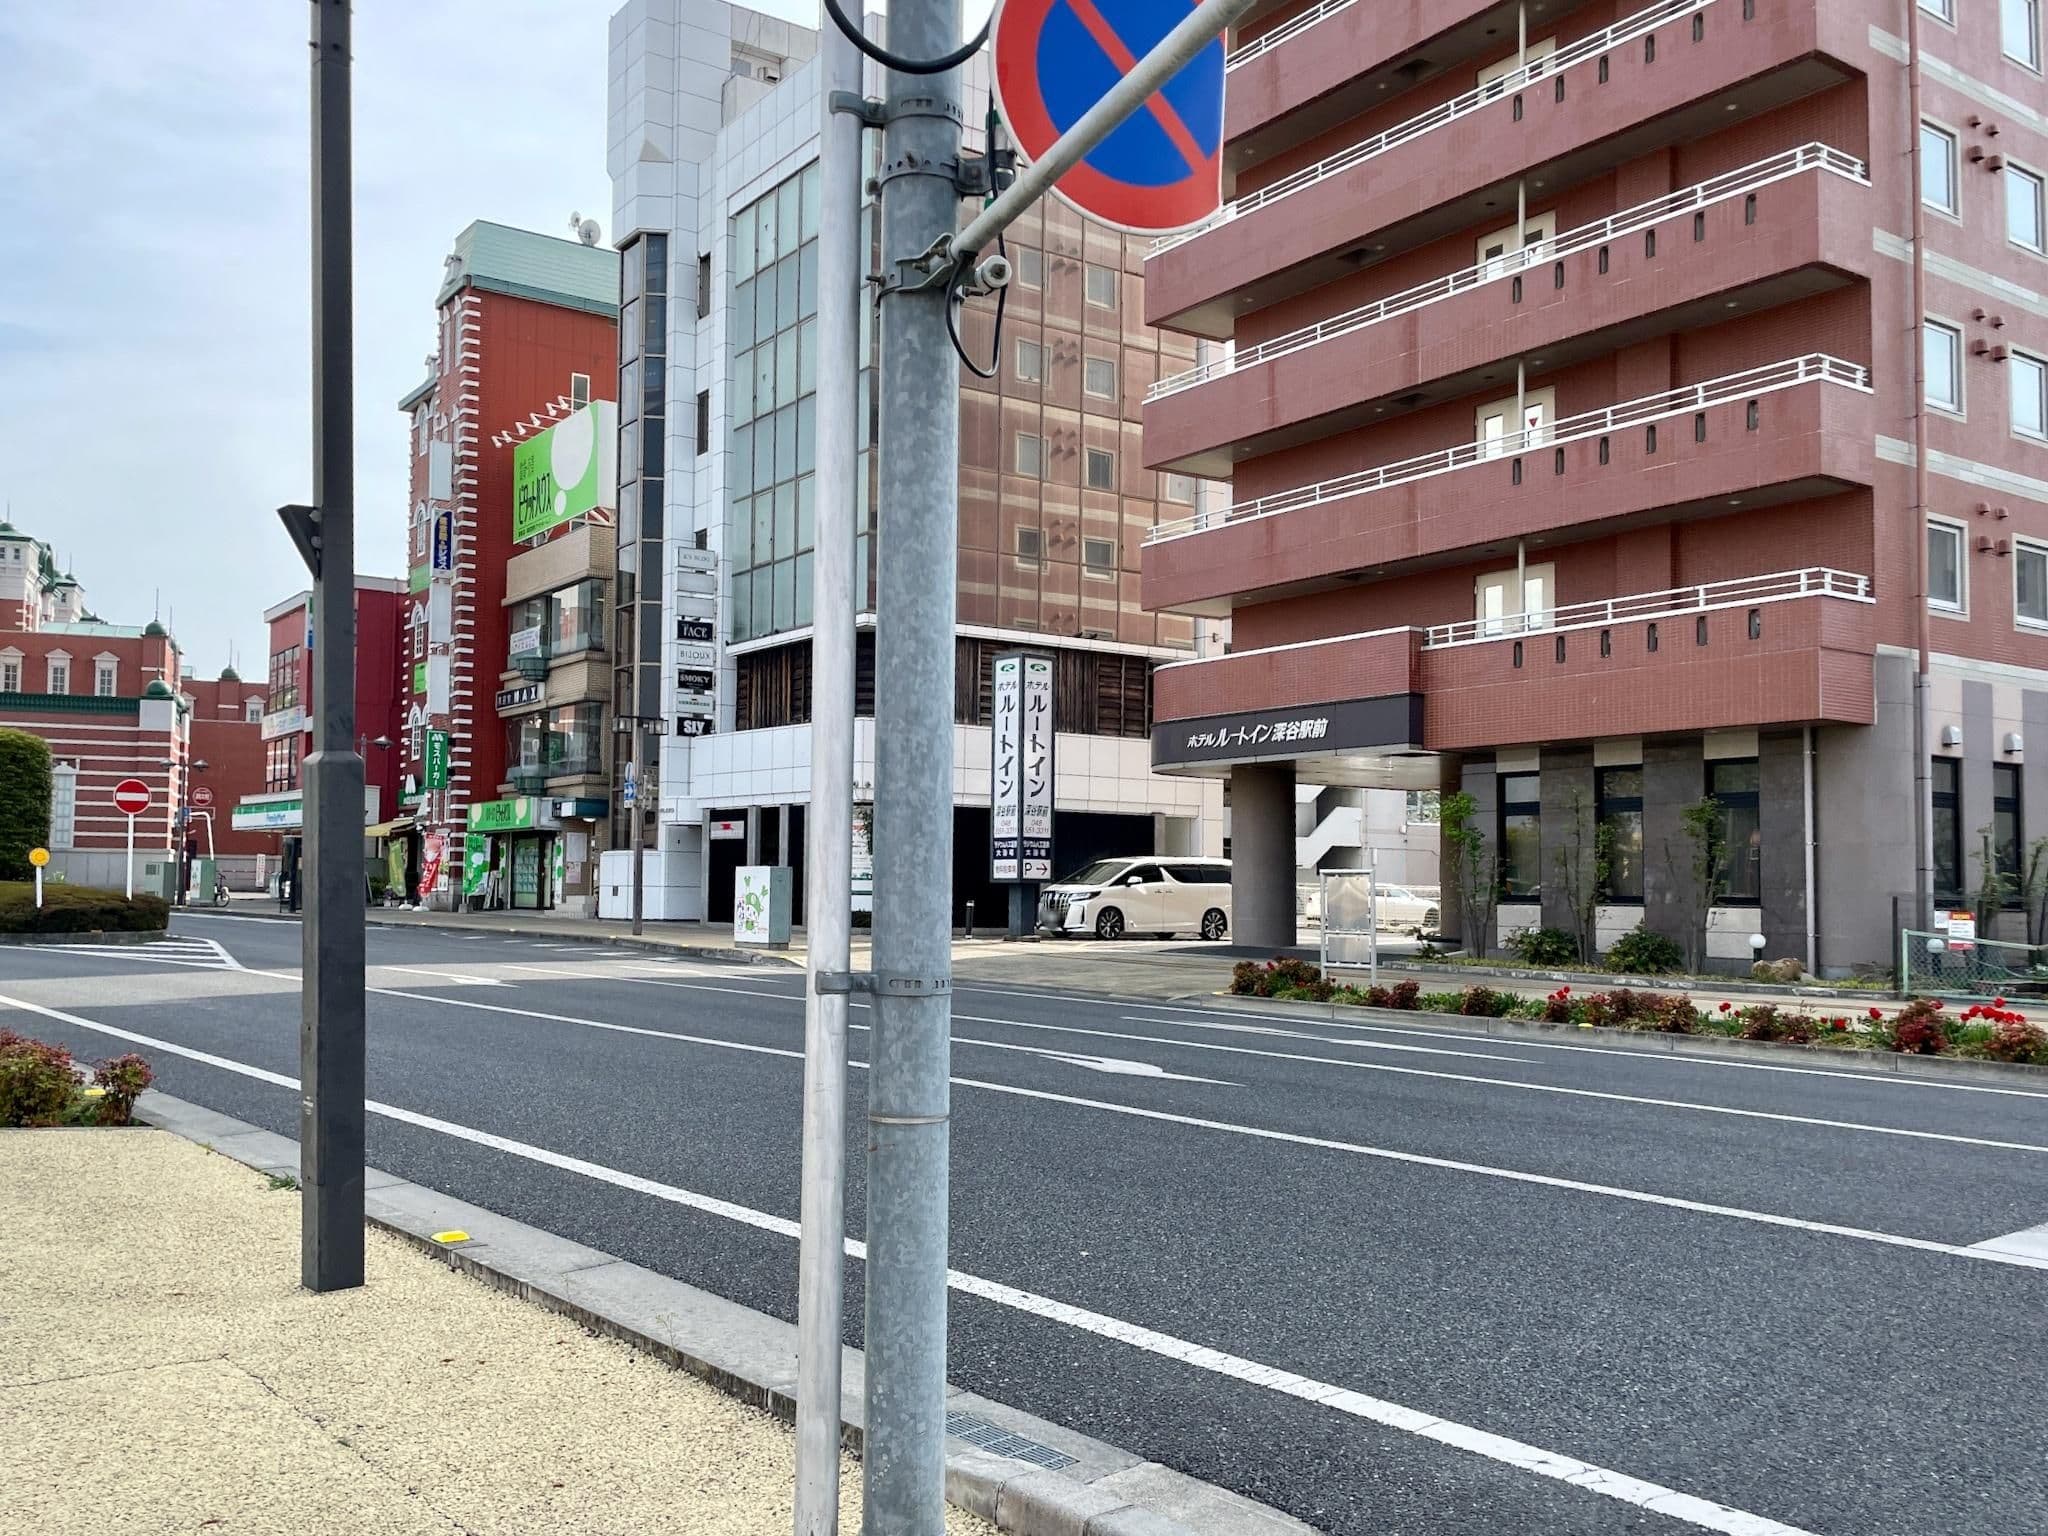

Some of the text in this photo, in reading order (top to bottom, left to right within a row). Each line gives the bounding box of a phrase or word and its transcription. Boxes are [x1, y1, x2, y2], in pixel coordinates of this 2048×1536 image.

[518, 472, 552, 525] ピタットハウス
[680, 673, 711, 684] SMOKY
[998, 681, 1017, 691] ホテル
[1026, 680, 1050, 691] ホテル
[999, 694, 1016, 799] ルートイン
[1028, 694, 1048, 798] ルートイン
[1186, 717, 1329, 748] ホテルルートイン深谷駅前
[432, 742, 441, 786] モスバーガー
[1024, 862, 1033, 876] P
